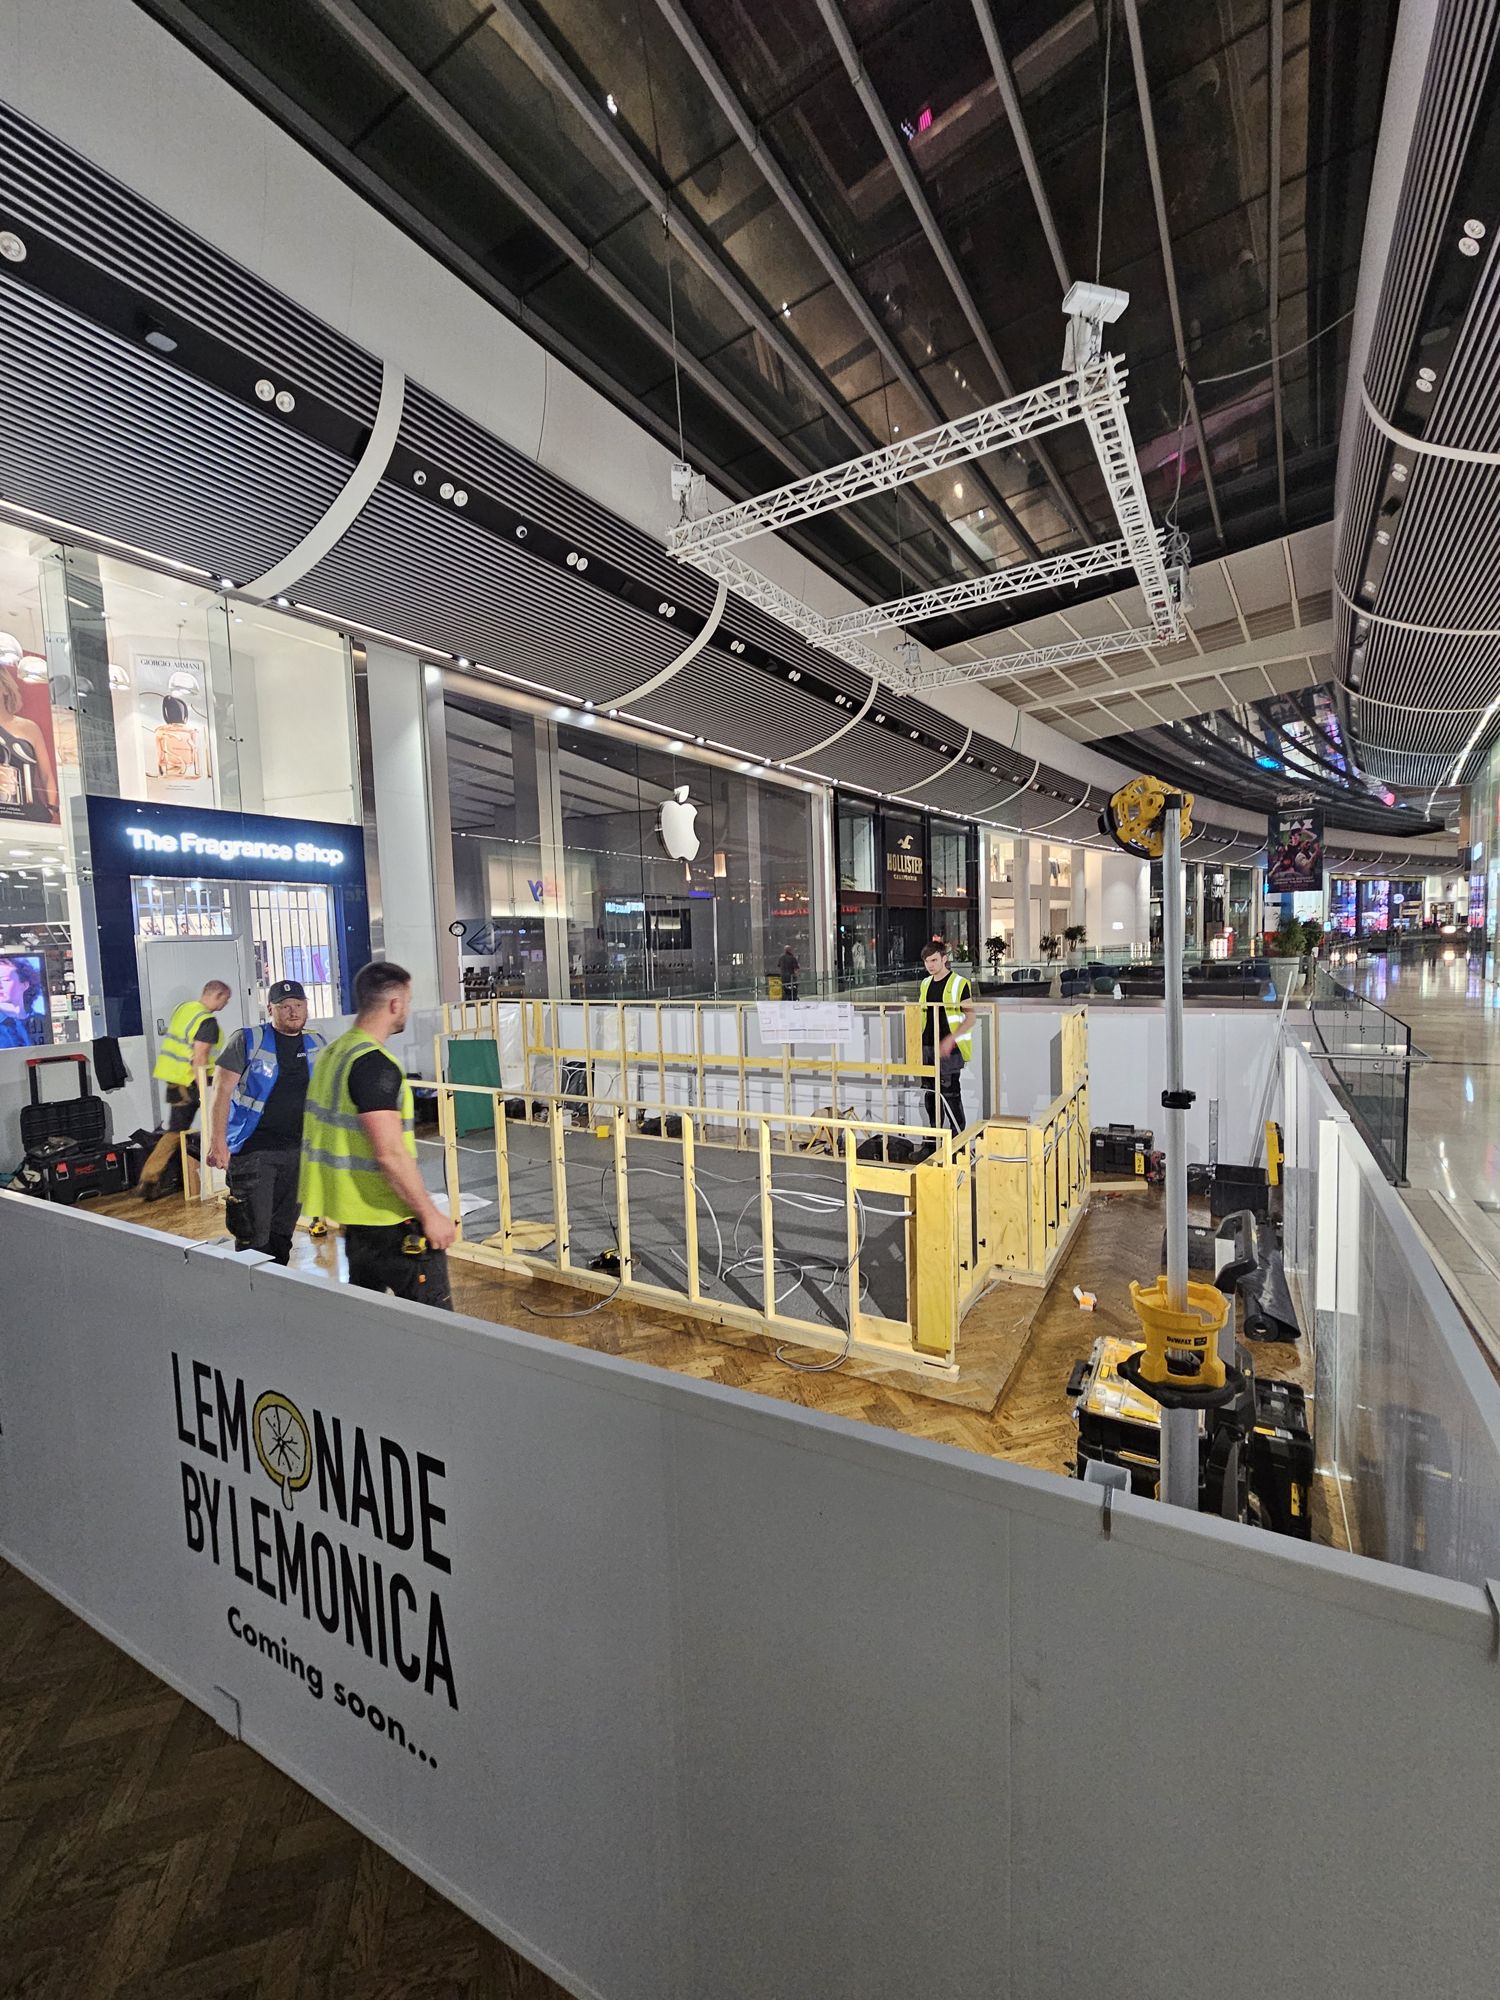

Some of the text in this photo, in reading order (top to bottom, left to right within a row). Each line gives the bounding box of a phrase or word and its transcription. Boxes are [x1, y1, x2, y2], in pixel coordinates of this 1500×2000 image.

[140, 659, 200, 670] GIORGIO ARMANI
[126, 827, 344, 866] The Fragrance Shop
[886, 853, 923, 875] HOLLISTER
[171, 1352, 452, 1575] LEMONADE
[181, 1461, 459, 1711] BY LEMONICA
[228, 1606, 438, 1769] Coming soon...
